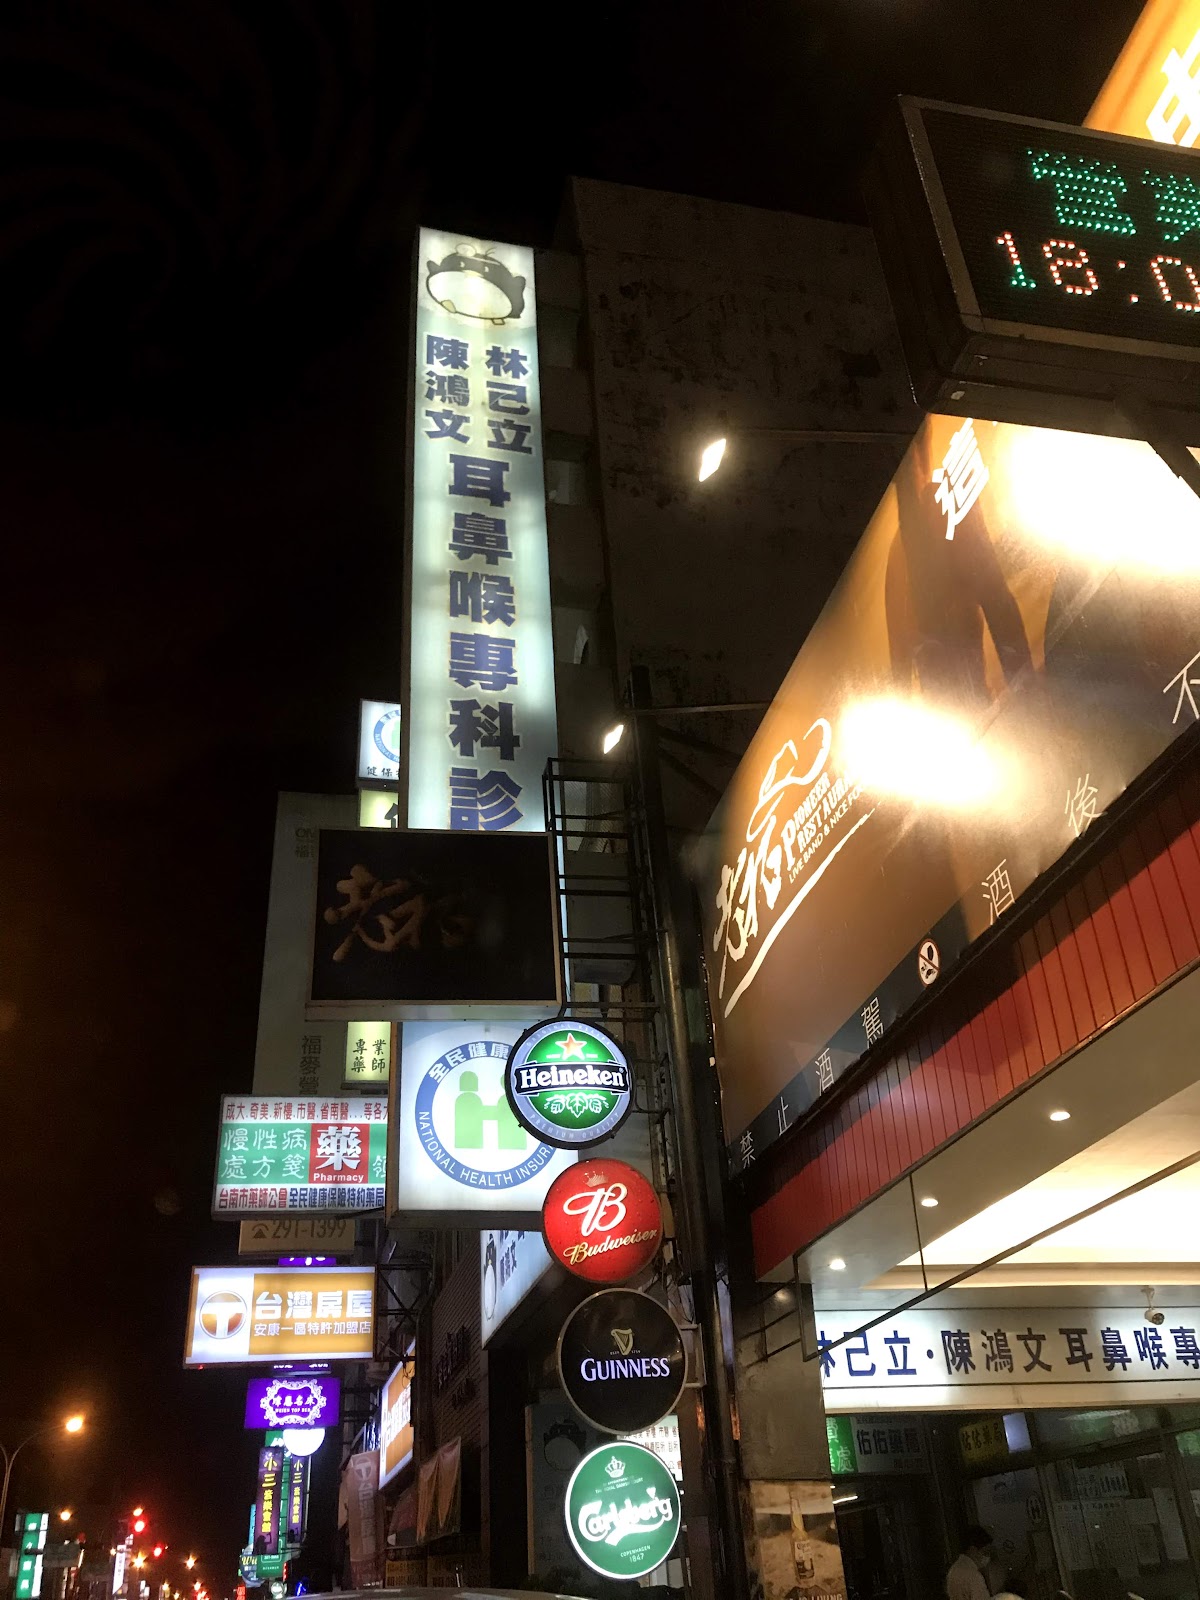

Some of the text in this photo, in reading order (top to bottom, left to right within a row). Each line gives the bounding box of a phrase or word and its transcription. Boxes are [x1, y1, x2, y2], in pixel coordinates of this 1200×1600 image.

[425, 334, 470, 444] 陳鴻文
[485, 345, 532, 455] 林己立
[448, 453, 524, 831] 耳鼻喉專科診
[803, 832, 823, 863] BAND
[353, 1039, 387, 1055] 專業
[351, 1056, 386, 1073] 藥師
[428, 1042, 510, 1084] 全民健康
[520, 1065, 625, 1088] Heineken
[223, 1127, 307, 1151] 慢性病
[315, 1126, 362, 1171] 藥
[418, 1111, 553, 1187] NATIONAL HEALTH INSUR
[220, 1153, 306, 1179] 處方箋
[313, 1173, 364, 1183] Pharmacy
[563, 1229, 658, 1265] Budweiser
[255, 1290, 373, 1320] 台灣房屋
[254, 1321, 372, 1337] 安康一區特許加盟店
[580, 1357, 670, 1382] GUINNESS
[578, 1486, 673, 1546] Carlsberg
[620, 1545, 651, 1557] COPENHAGEN
[629, 1553, 645, 1563] 1847
